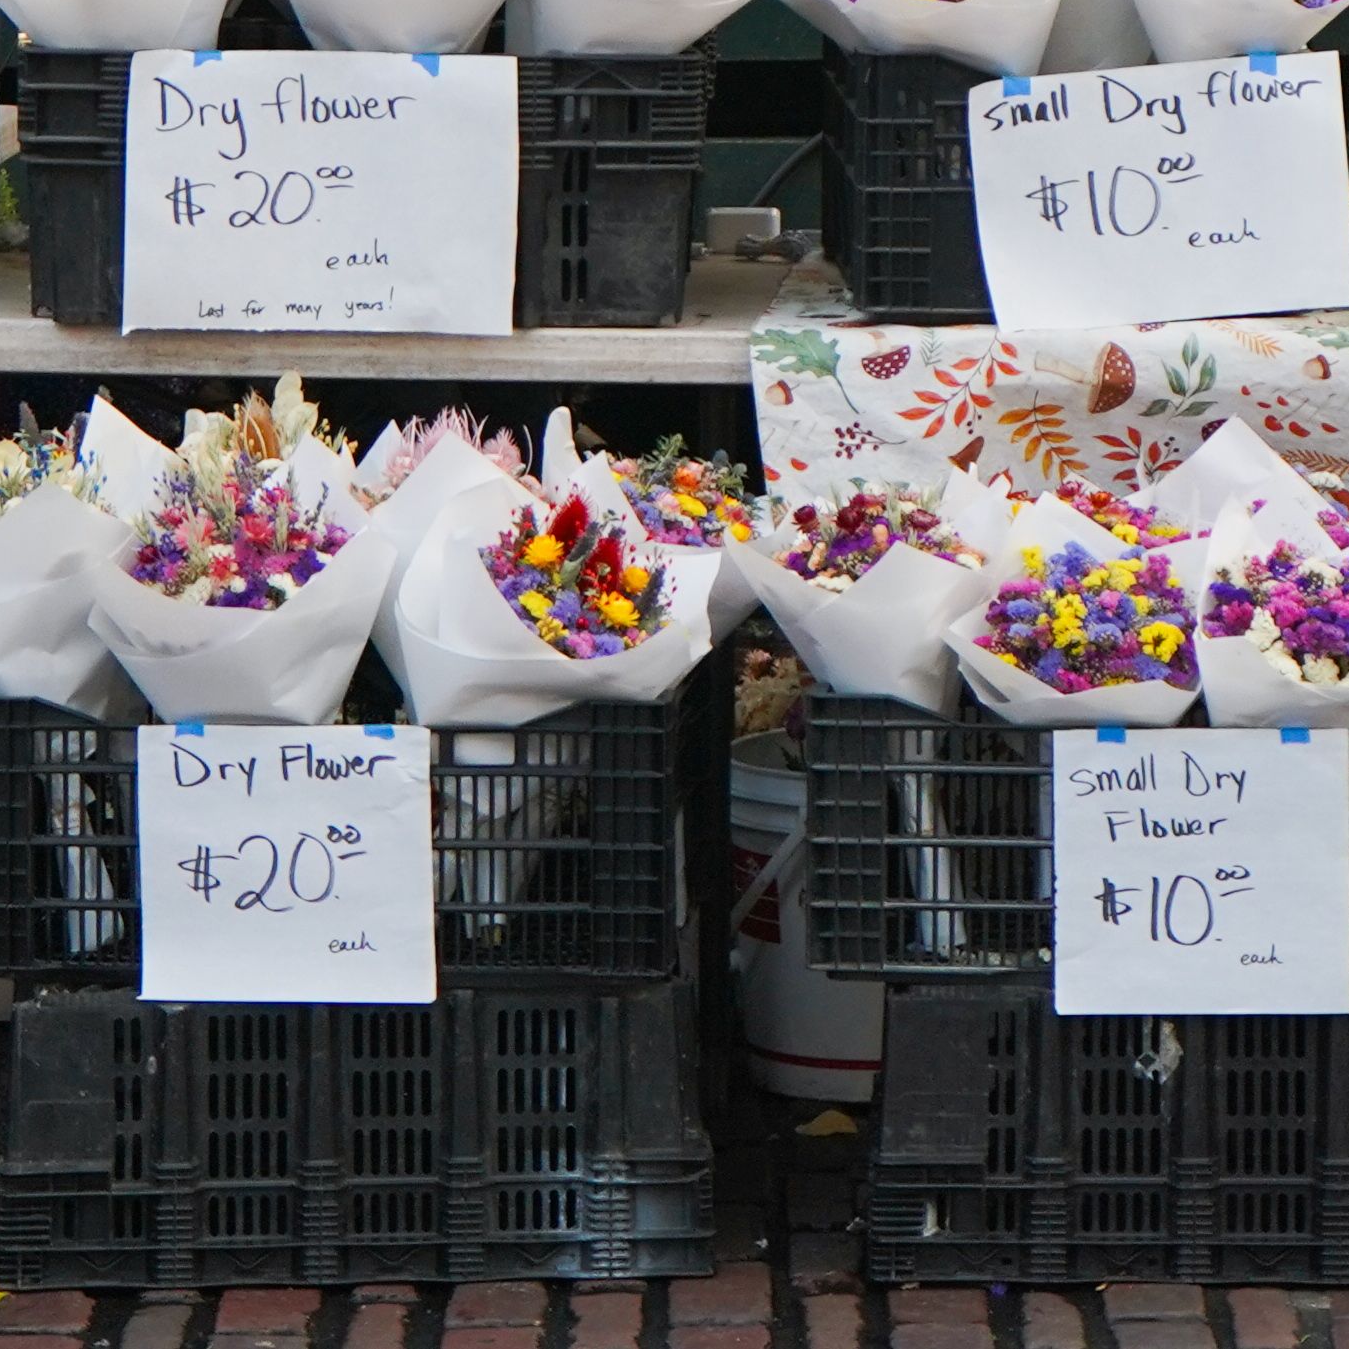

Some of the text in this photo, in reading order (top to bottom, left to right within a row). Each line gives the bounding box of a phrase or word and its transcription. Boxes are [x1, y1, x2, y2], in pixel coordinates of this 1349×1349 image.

[154, 74, 417, 160] Dry flower
[1097, 75, 1186, 134] Dry
[1188, 218, 1260, 247] each
[326, 238, 390, 270] each
[241, 299, 265, 318] for
[285, 301, 322, 320] many
[344, 286, 394, 321] years!
[169, 742, 396, 797] Dry Flower
[1181, 750, 1247, 804] Dry
[1104, 807, 1228, 842] Flower
[328, 931, 377, 953] each
[1240, 943, 1284, 965] each
